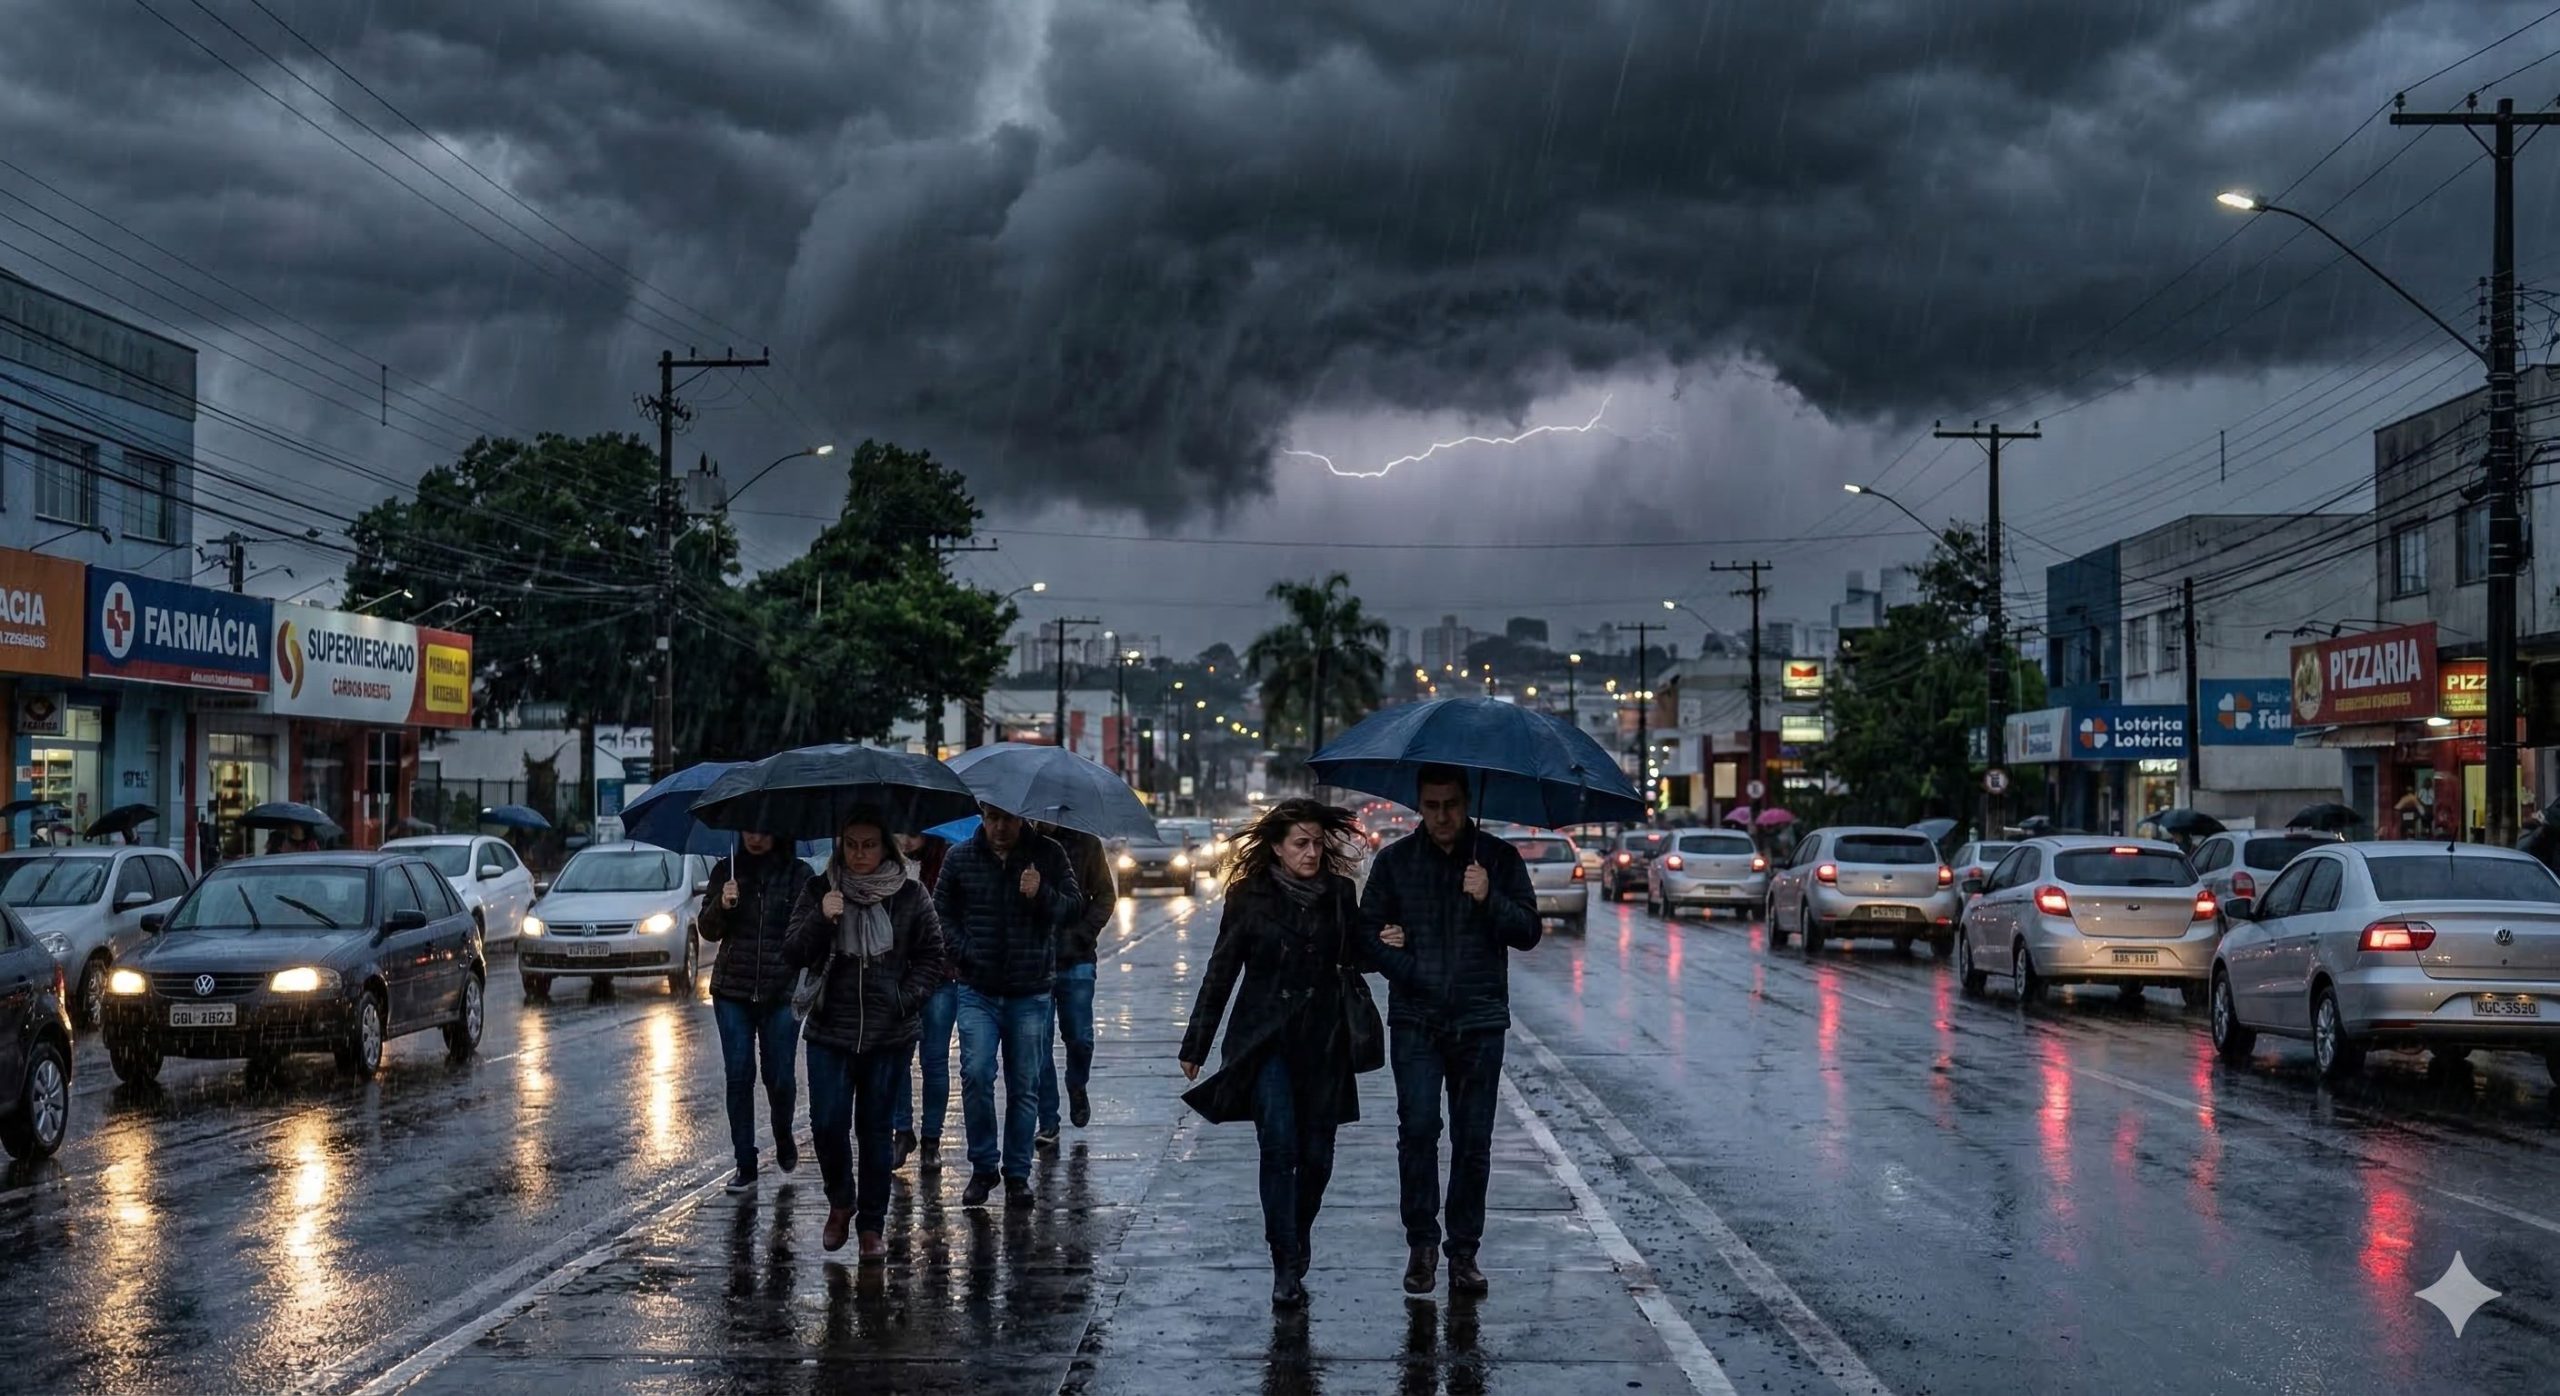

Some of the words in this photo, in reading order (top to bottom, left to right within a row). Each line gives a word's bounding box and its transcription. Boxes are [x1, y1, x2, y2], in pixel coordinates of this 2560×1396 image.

[144, 606, 259, 659] FARMÁCIA
[307, 627, 415, 674] SUPERMERCADO
[2329, 638, 2422, 691] PIZZARIA
